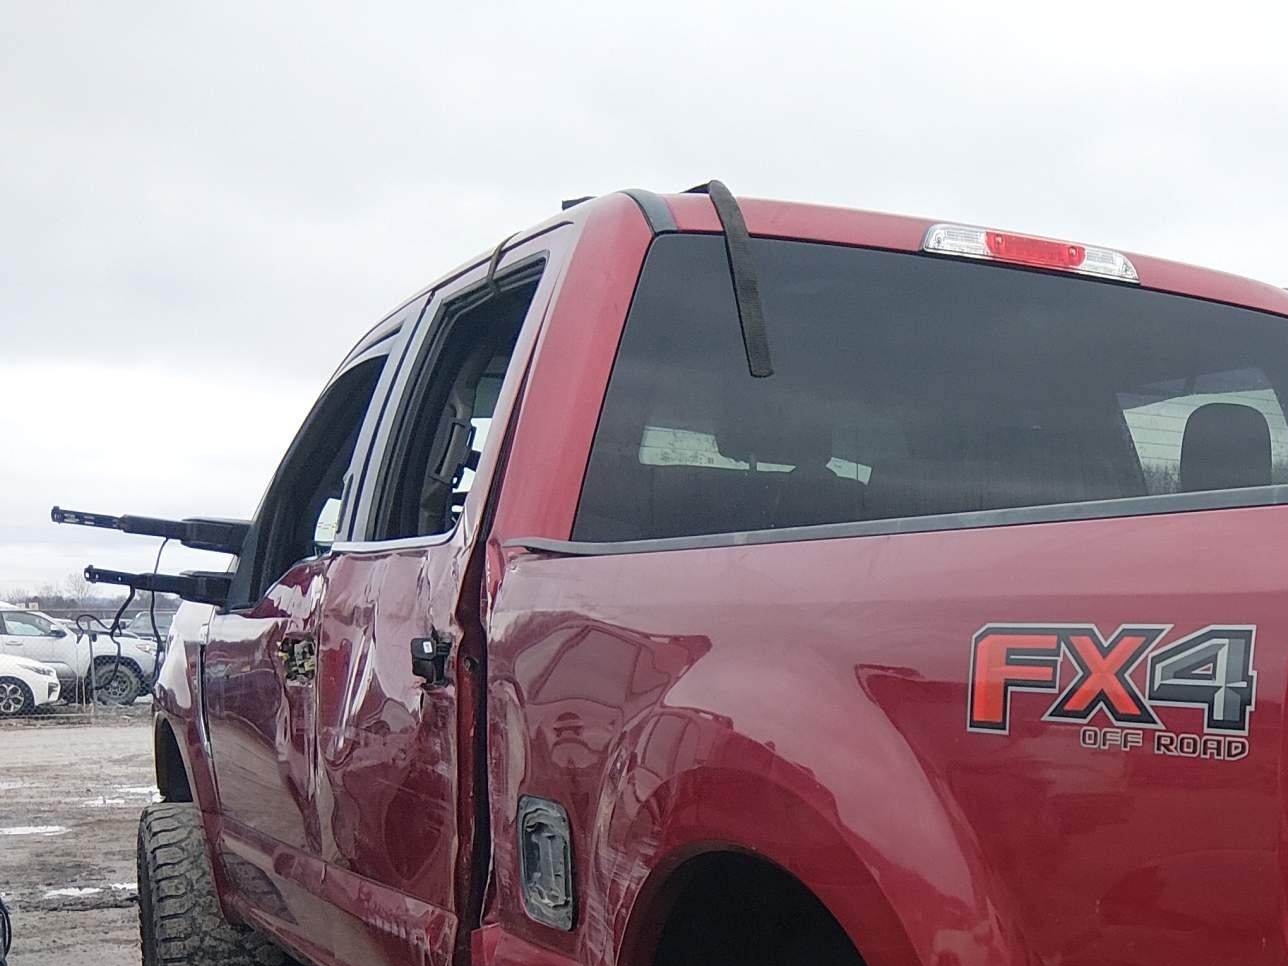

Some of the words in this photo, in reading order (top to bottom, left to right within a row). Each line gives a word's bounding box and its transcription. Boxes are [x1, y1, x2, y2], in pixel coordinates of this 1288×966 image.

[967, 623, 1257, 736] FX4
[1080, 726, 1143, 751] OFF
[1154, 732, 1249, 760] ROAD
